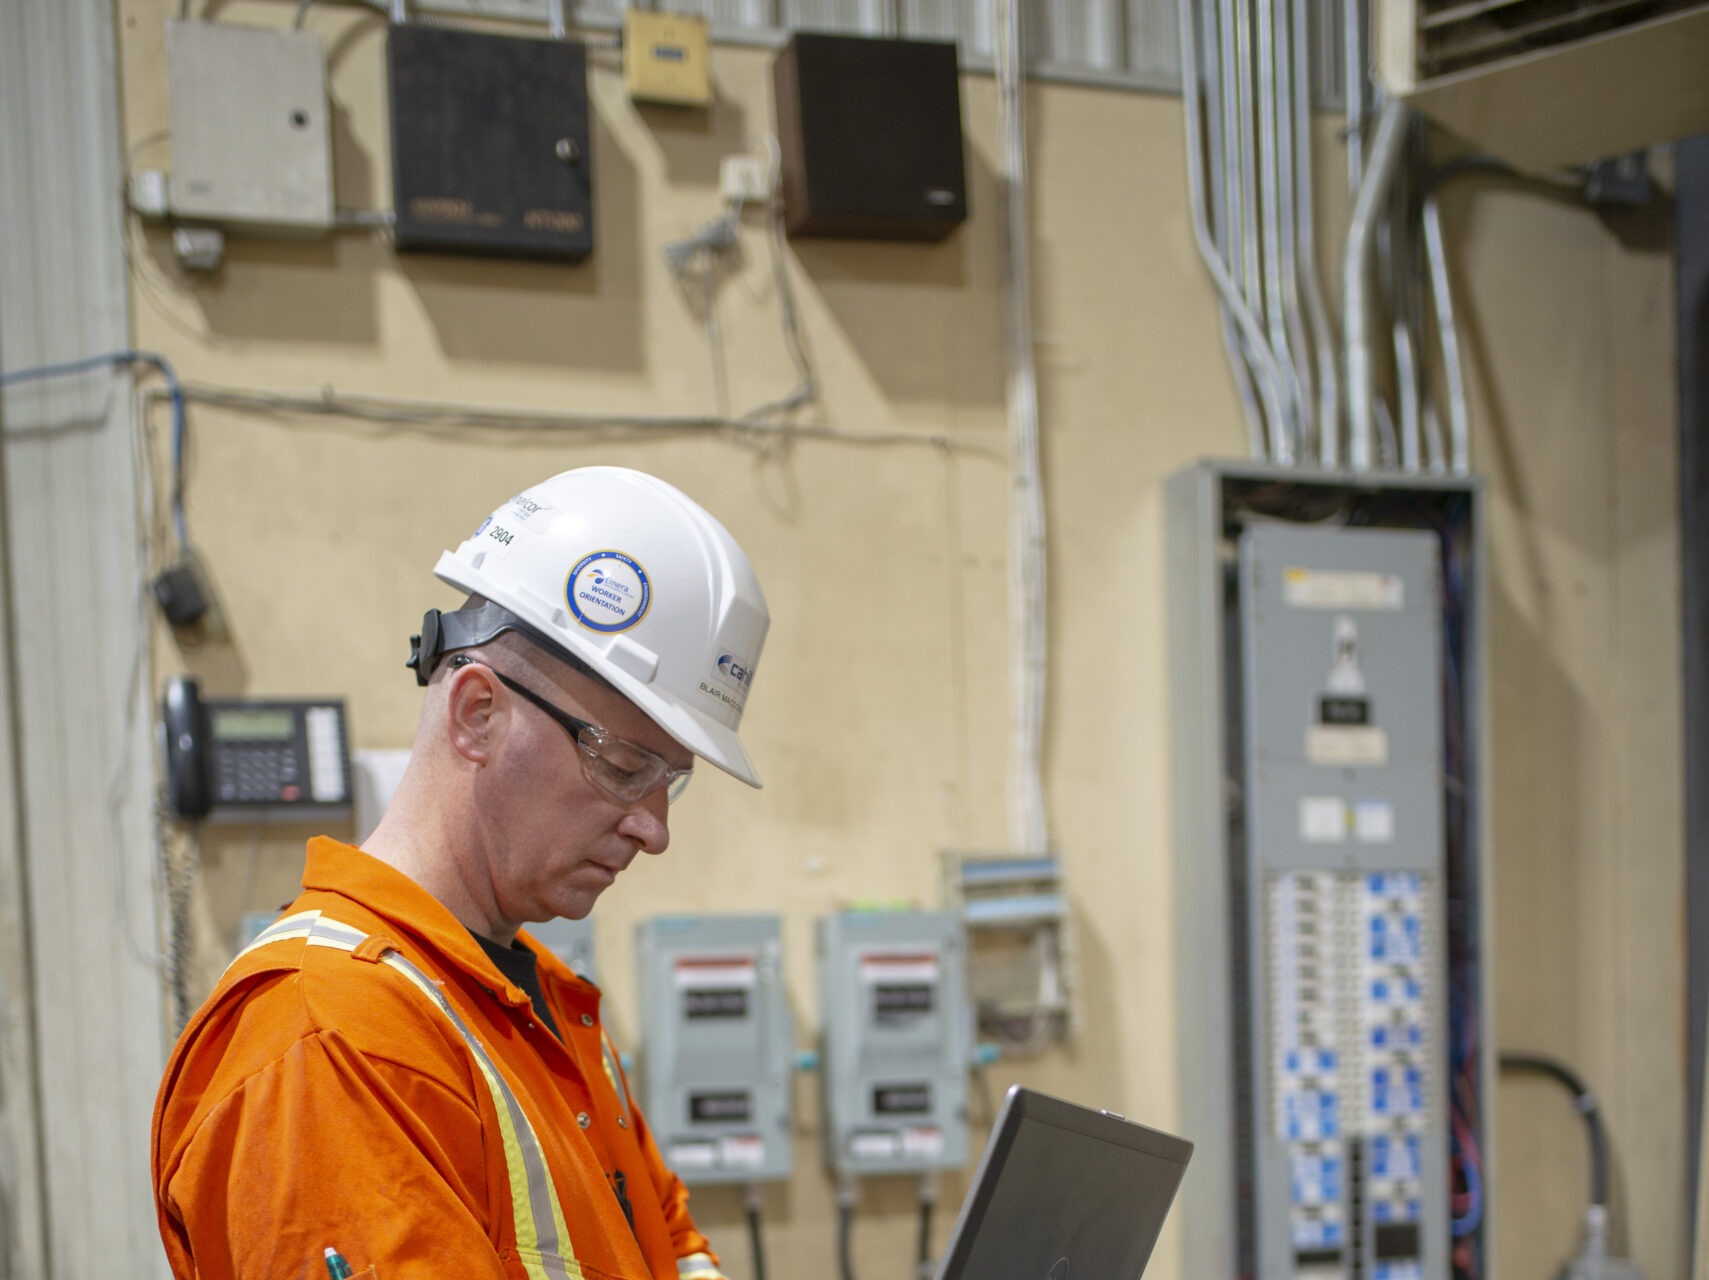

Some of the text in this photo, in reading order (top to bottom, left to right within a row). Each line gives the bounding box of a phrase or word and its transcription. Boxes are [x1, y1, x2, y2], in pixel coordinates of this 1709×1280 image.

[489, 525, 514, 546] 2904
[615, 553, 632, 564] SAFETY
[604, 577, 629, 593] Emera
[591, 585, 622, 604] WORKER
[579, 591, 626, 616] ORIENTATION
[699, 682, 722, 698] BLAIR
